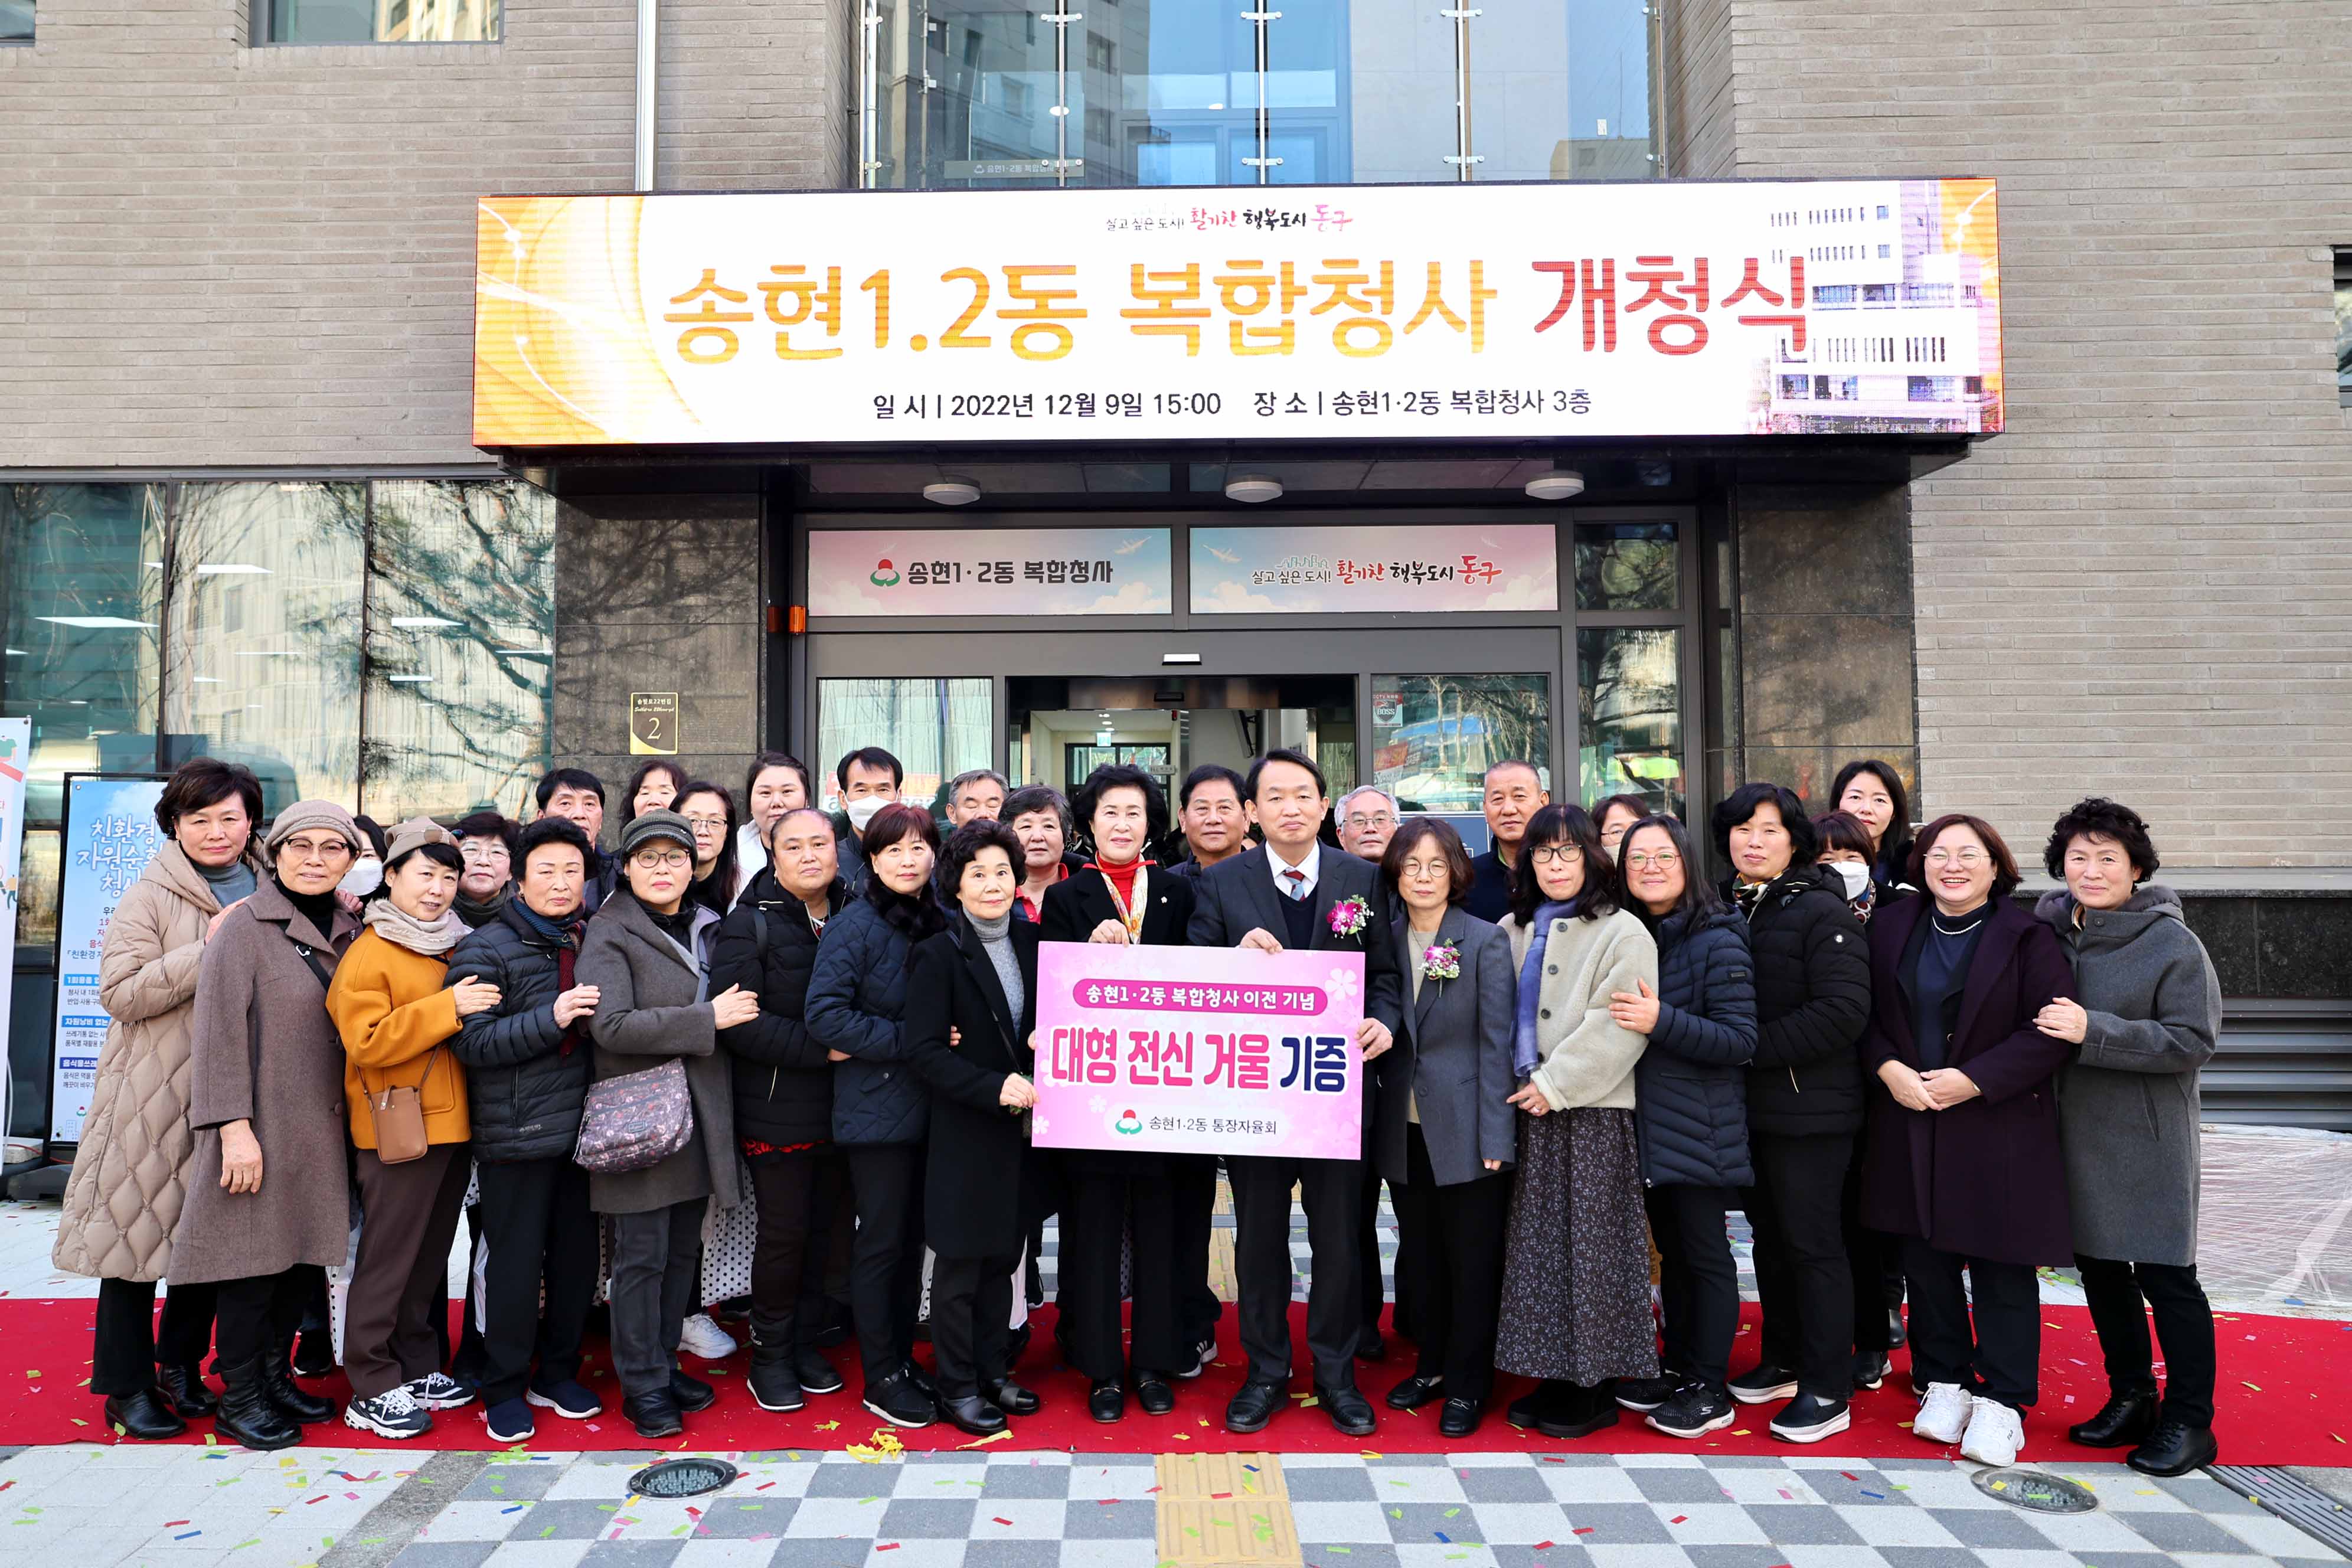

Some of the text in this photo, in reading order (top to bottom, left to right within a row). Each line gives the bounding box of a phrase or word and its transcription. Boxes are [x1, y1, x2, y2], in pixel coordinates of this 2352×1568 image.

[1106, 204, 1354, 233] 살고 싶은 도시! 활기찬 행복도시 동구
[663, 255, 1807, 363] 송현1.2동 복합청사 개청식
[951, 392, 1034, 418] 2022년
[1044, 391, 1097, 418] 12월
[1105, 391, 1143, 416] 9일
[1154, 393, 1222, 416] 15:00
[1331, 390, 1440, 416] 송현1·2동
[1450, 388, 1545, 414] 복합청사
[1553, 390, 1593, 414] 3층
[907, 559, 1113, 584] 송현1·2동 복합청사
[1252, 555, 1503, 585] 살고 싶은 도시! 활기찬 행복도시 동구
[647, 717, 662, 740] 2
[91, 813, 156, 845] 친환경
[1086, 984, 1316, 1011] 송현1·2동 복합청사 이전 기념
[1051, 1026, 1347, 1093] 대형 전신 거울 기증
[1149, 1116, 1277, 1135] 송현1·2동 통장자율회
